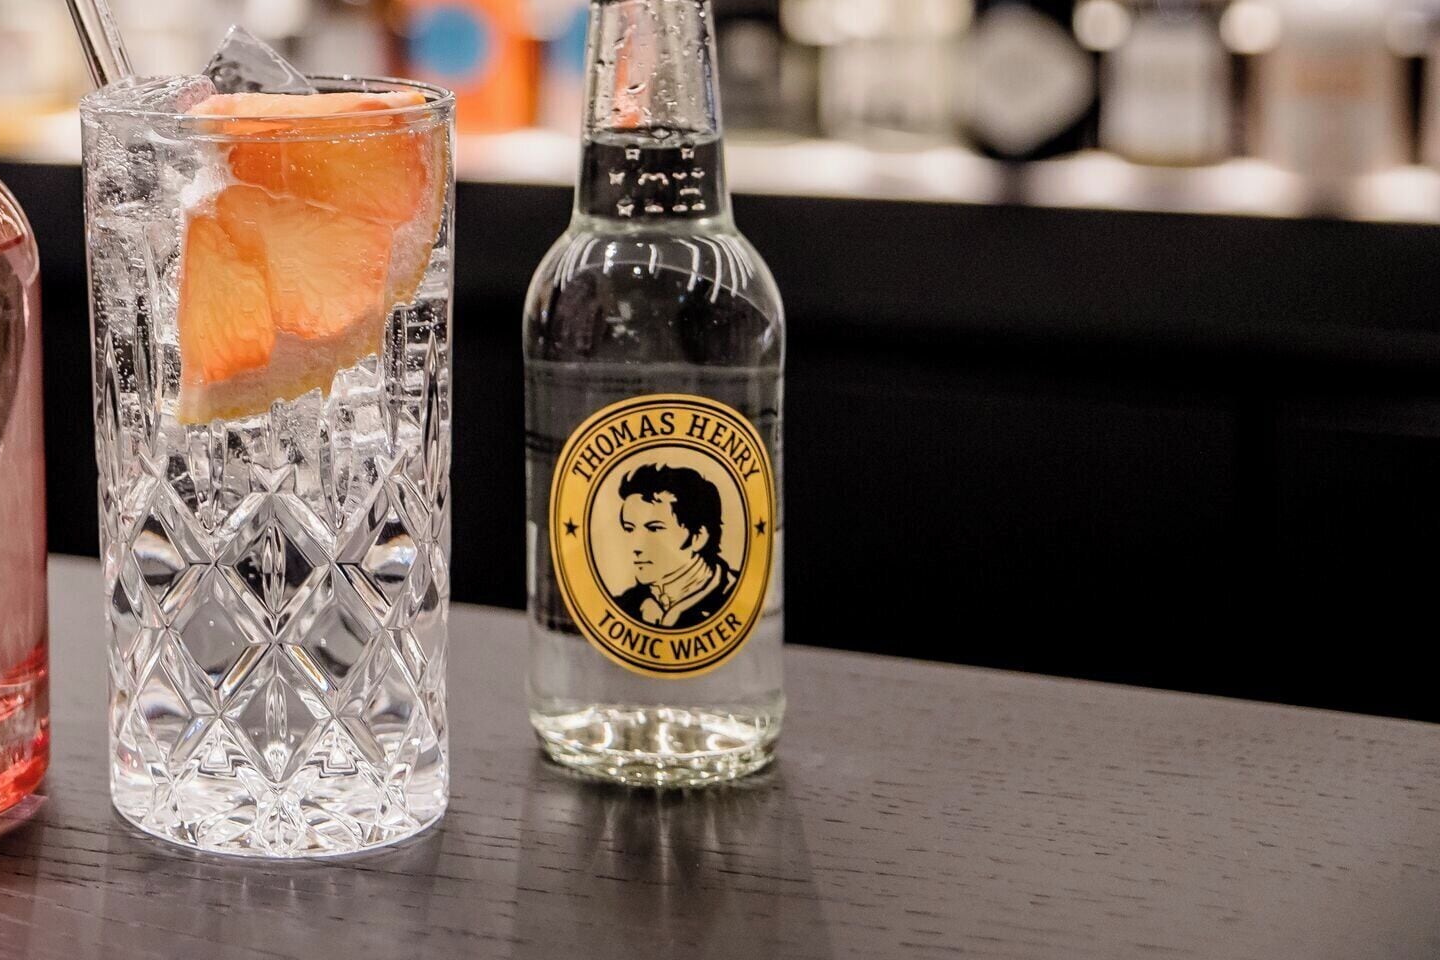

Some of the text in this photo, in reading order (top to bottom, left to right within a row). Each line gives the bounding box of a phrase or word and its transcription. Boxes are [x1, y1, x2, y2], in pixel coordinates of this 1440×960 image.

[572, 411, 760, 483] THOMAS HENRY
[598, 609, 742, 660] TONIC WATER
